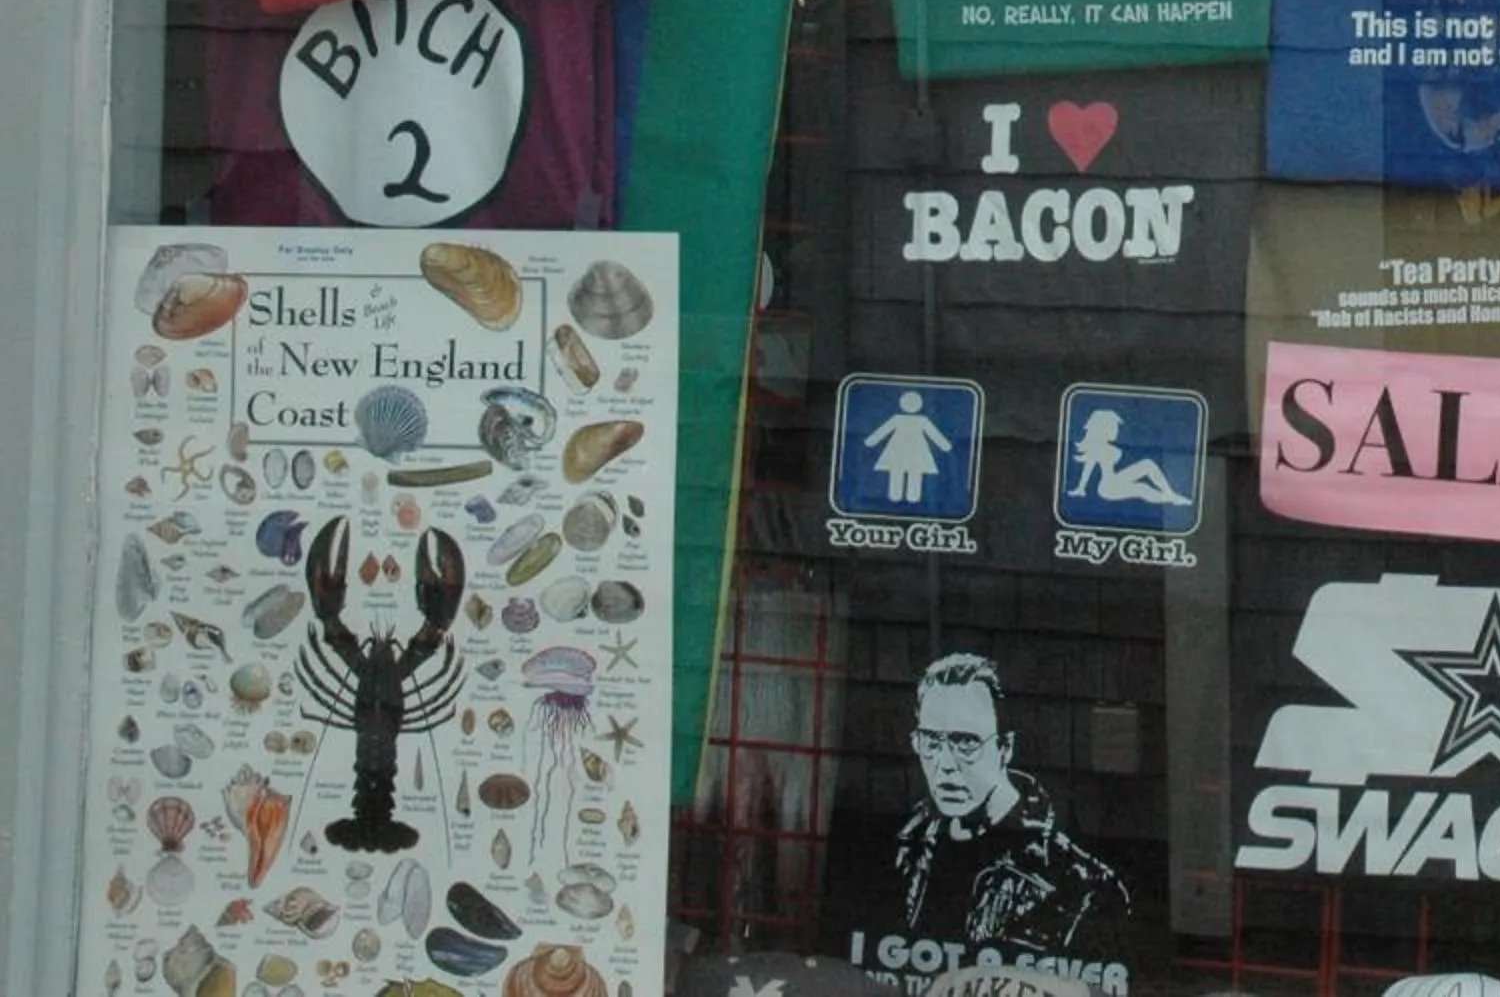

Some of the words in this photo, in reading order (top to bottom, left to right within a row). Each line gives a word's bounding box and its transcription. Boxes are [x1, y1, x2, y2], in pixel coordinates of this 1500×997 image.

[1084, 4, 1103, 24] IT
[1110, 3, 1149, 23] CAN
[1158, 0, 1232, 21] HAPPEN
[1351, 11, 1406, 38] This
[1415, 11, 1437, 38] is
[1446, 13, 1493, 39] not
[1349, 43, 1391, 65] and
[1398, 44, 1405, 65] I
[1412, 47, 1447, 65] am
[1453, 45, 1494, 65] not
[981, 103, 1021, 174] I
[383, 120, 450, 203] 2
[903, 185, 1194, 262] BACON
[248, 285, 356, 328] Shells
[1338, 290, 1398, 307] sounds
[1401, 292, 1420, 306] so
[1423, 285, 1468, 304] much
[1354, 309, 1370, 327] of
[1374, 306, 1433, 327] Racists
[1436, 305, 1467, 324] and
[247, 359, 273, 377] the
[280, 341, 358, 377] New
[371, 339, 526, 388] England
[248, 337, 265, 355] of
[247, 391, 350, 428] Coast
[827, 519, 903, 547] Your
[905, 523, 977, 553] Girl.
[1055, 531, 1116, 564] My
[1120, 535, 1197, 567] Girl.
[851, 931, 864, 965] I
[877, 934, 966, 974] GOT
